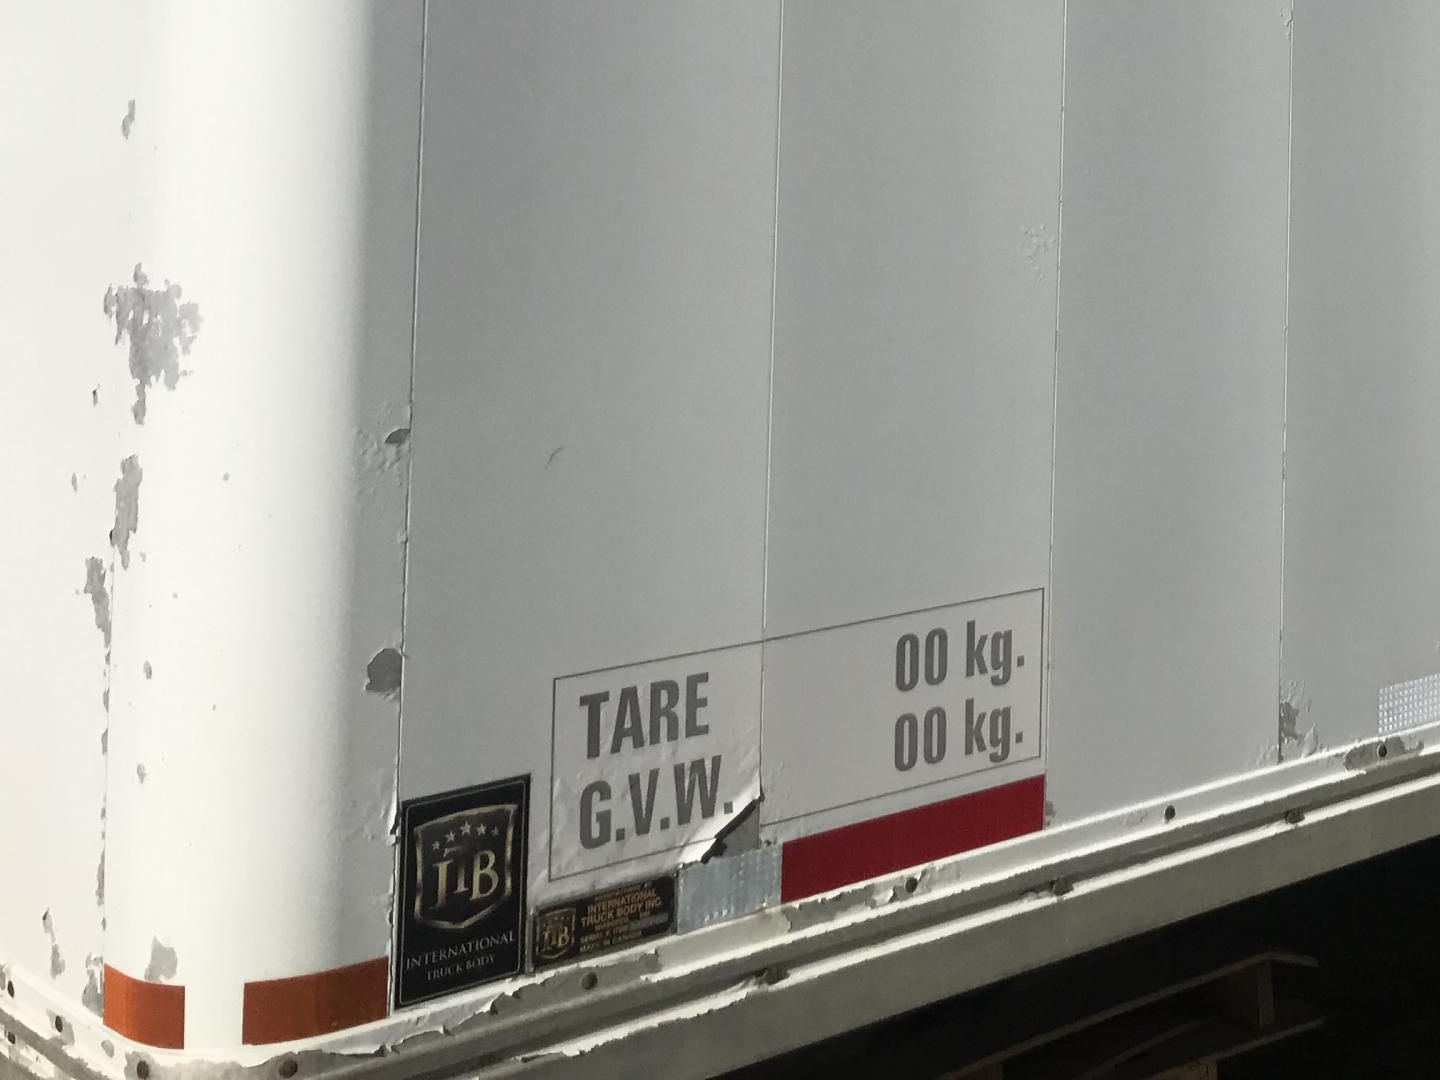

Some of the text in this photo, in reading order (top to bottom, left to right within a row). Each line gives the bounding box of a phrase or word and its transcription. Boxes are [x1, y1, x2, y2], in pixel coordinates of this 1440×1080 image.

[965, 620, 1025, 687] kg.
[579, 672, 709, 760] TARE
[964, 697, 1024, 764] kg.
[579, 754, 733, 850] G.V.W.
[588, 888, 658, 913] INTERNATIONAL
[616, 905, 642, 919] BODY
[405, 929, 517, 971] INTERNATIONAL
[426, 952, 497, 982] TRUCK BODY
